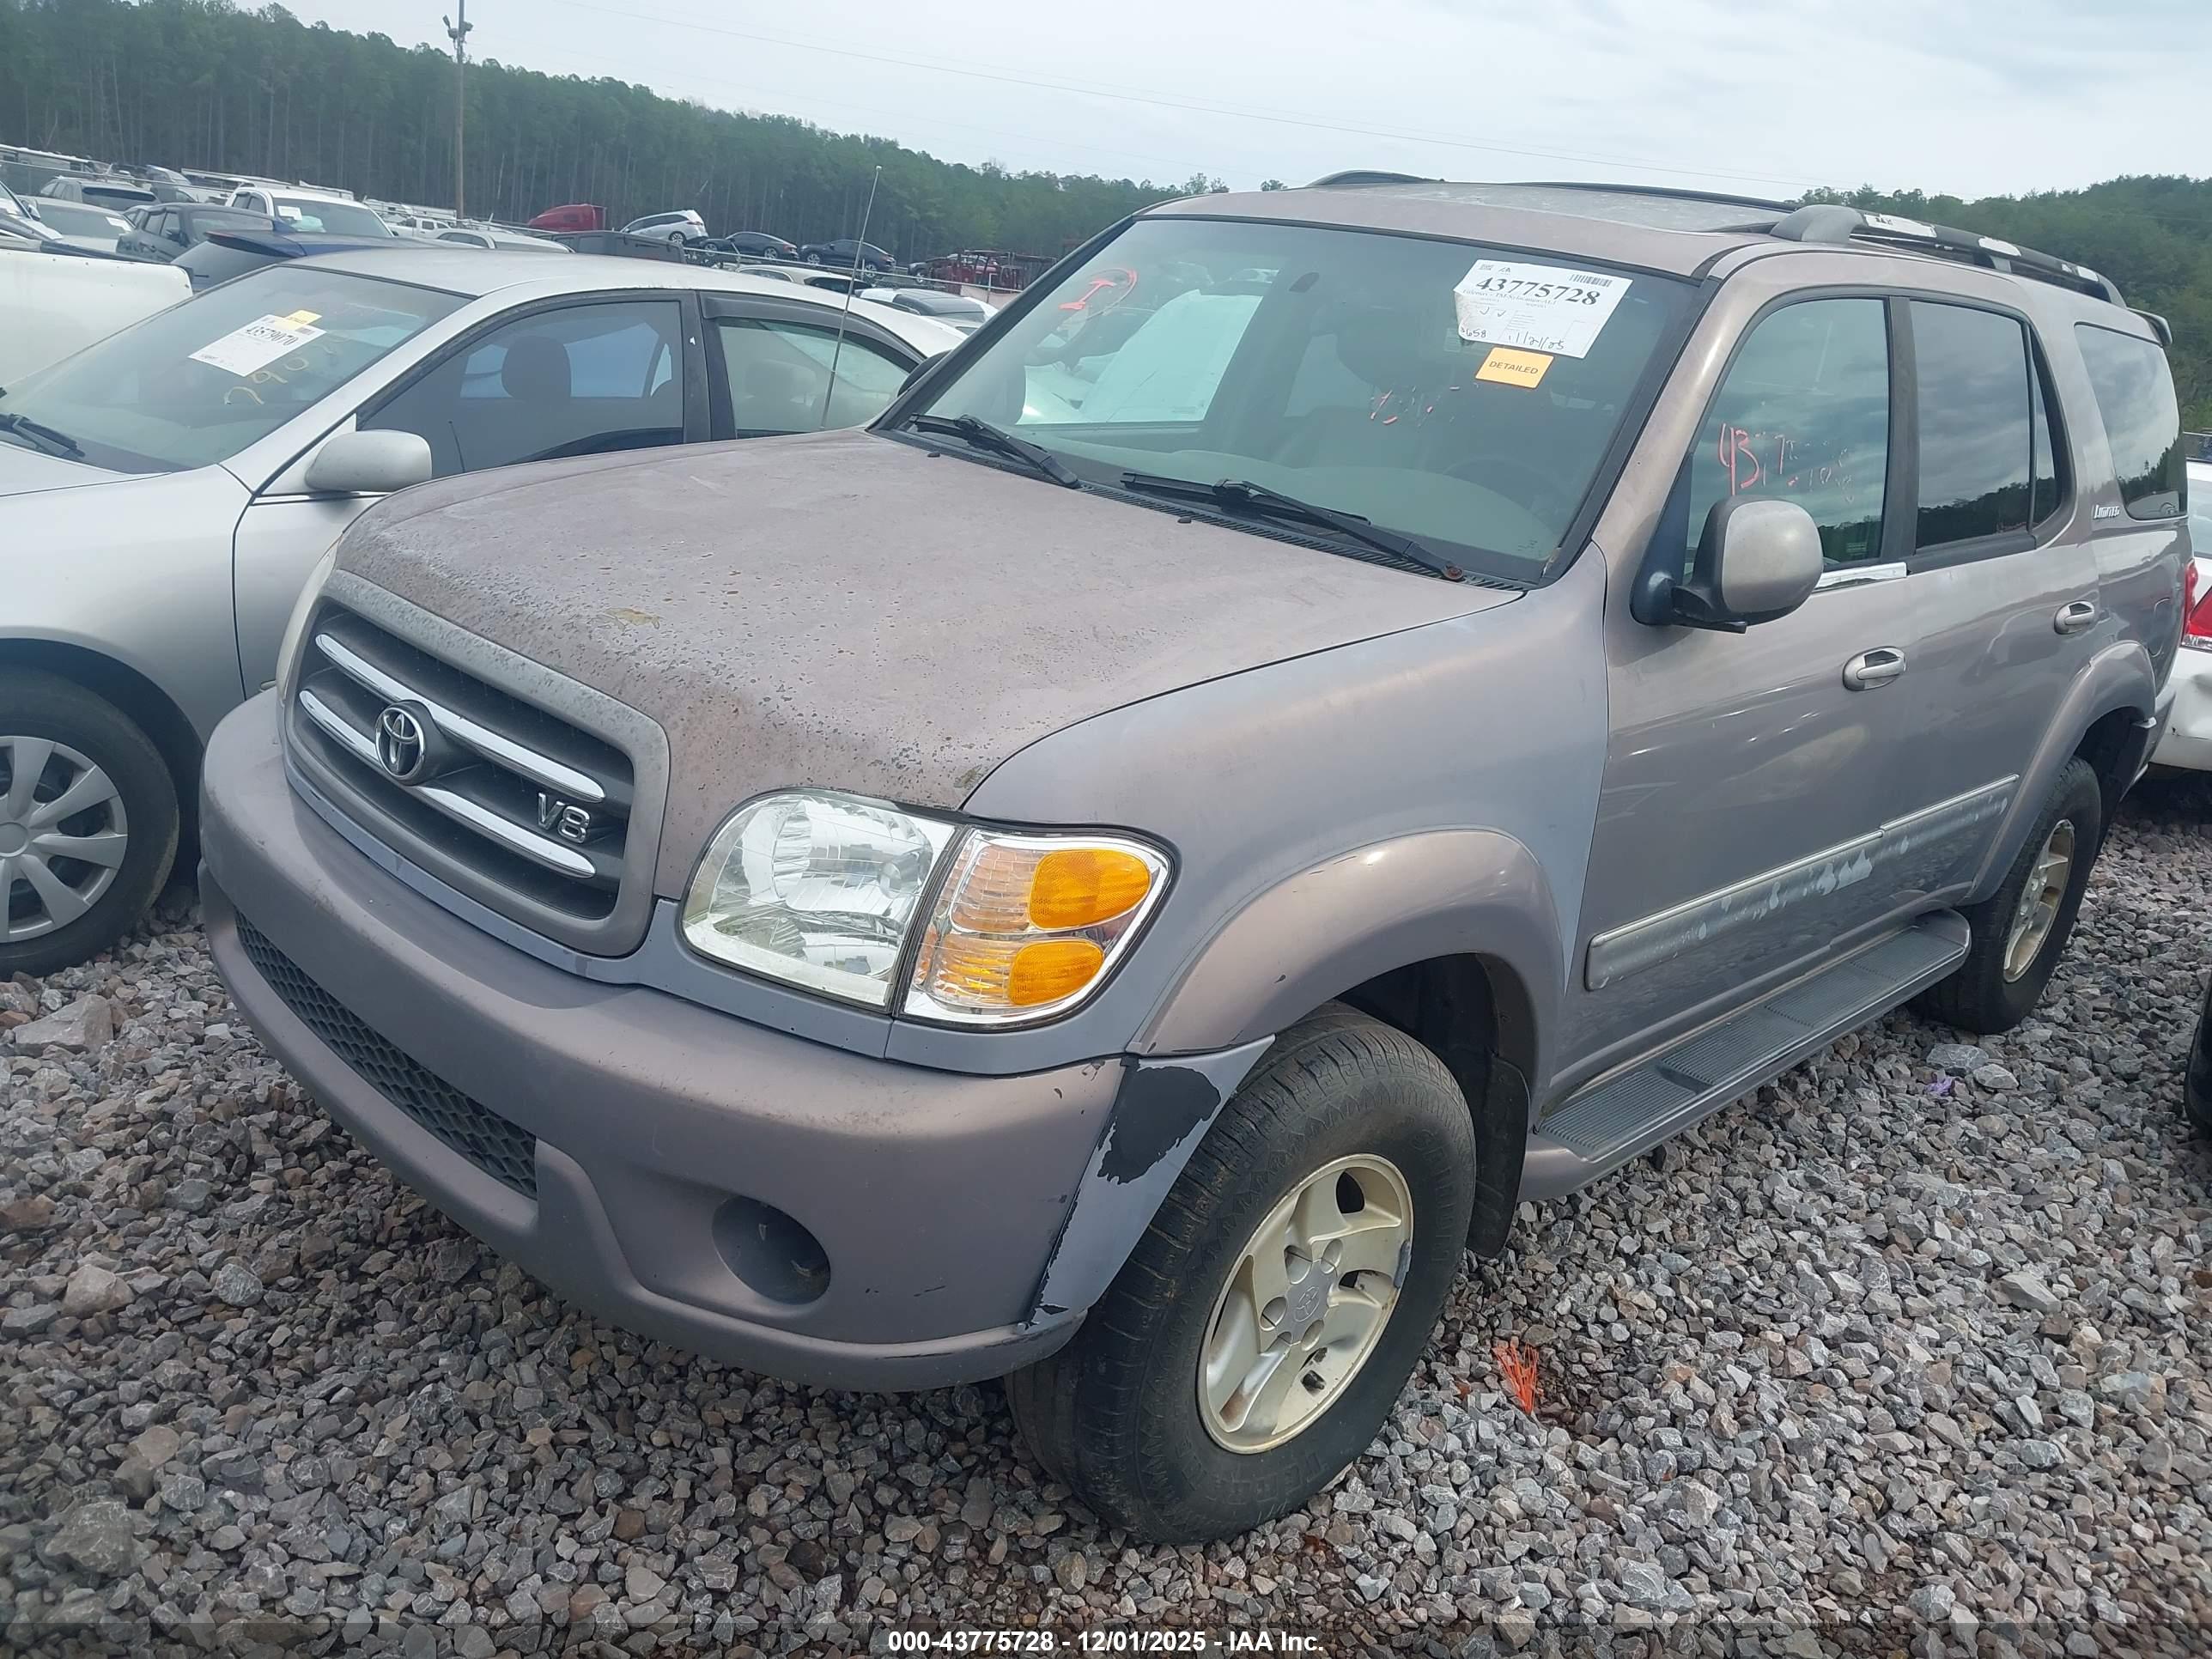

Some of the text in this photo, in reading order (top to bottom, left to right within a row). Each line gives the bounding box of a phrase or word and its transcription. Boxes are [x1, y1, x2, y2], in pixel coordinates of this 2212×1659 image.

[1475, 276, 1601, 307] 43775728
[1488, 361, 1539, 375] DETAILED
[538, 792, 591, 844] V8
